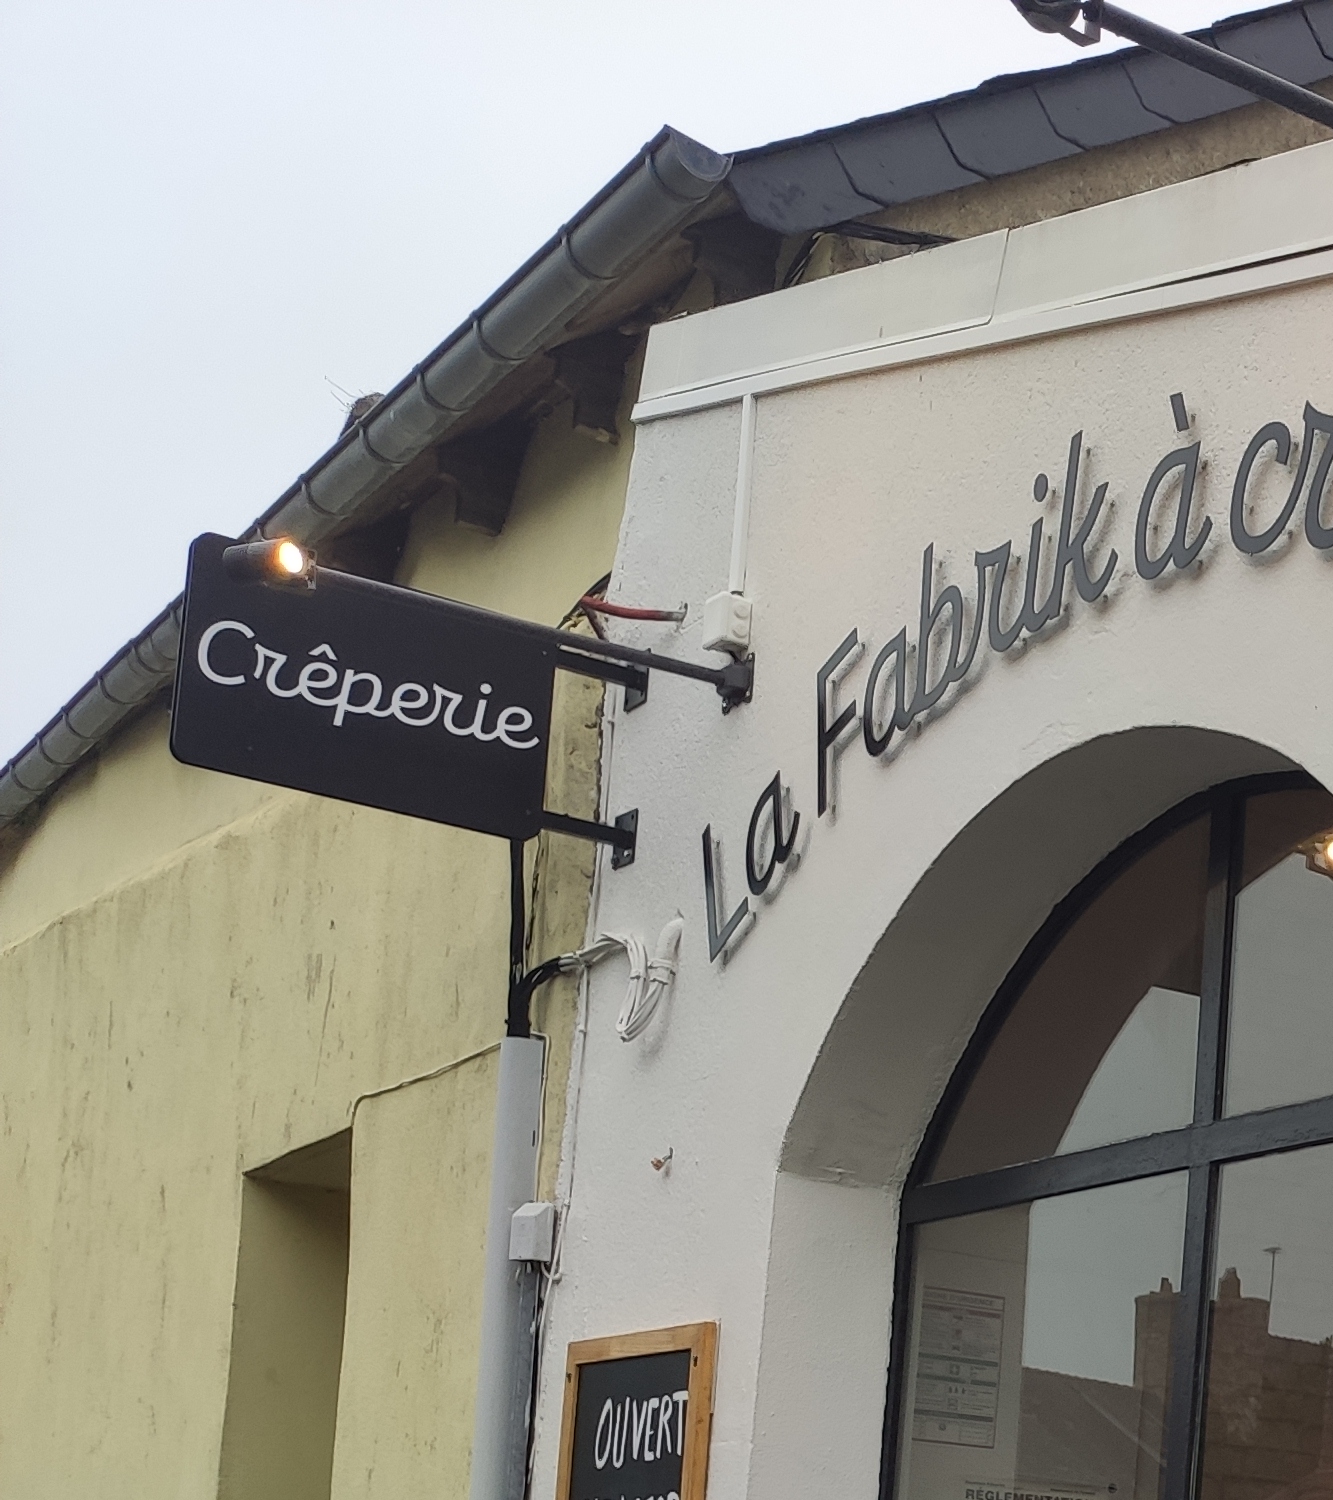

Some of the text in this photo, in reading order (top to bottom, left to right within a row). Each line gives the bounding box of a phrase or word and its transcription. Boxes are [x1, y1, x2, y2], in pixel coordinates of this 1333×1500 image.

[198, 620, 540, 750] Crêperie
[701, 770, 800, 963] La
[816, 429, 1118, 818] Fabrik
[1135, 392, 1213, 580] à
[595, 1390, 689, 1470] OUVERT
